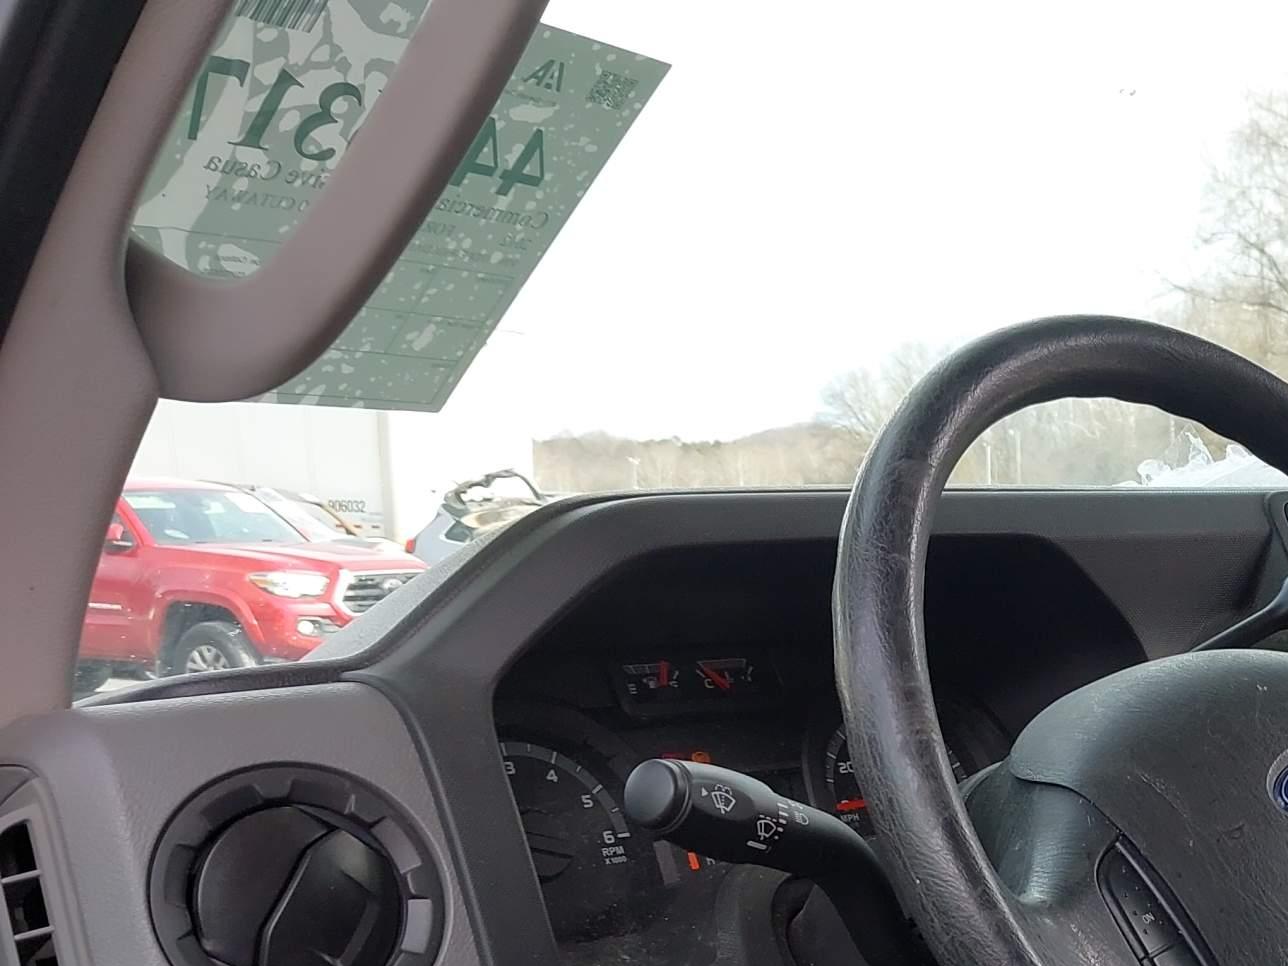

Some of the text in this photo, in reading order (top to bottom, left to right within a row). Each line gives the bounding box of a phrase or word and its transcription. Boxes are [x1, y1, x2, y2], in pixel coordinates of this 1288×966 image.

[504, 761, 517, 776] 3
[545, 770, 559, 783] 4
[580, 794, 594, 808] 5
[602, 830, 616, 844] 6
[601, 845, 625, 857] RPM
